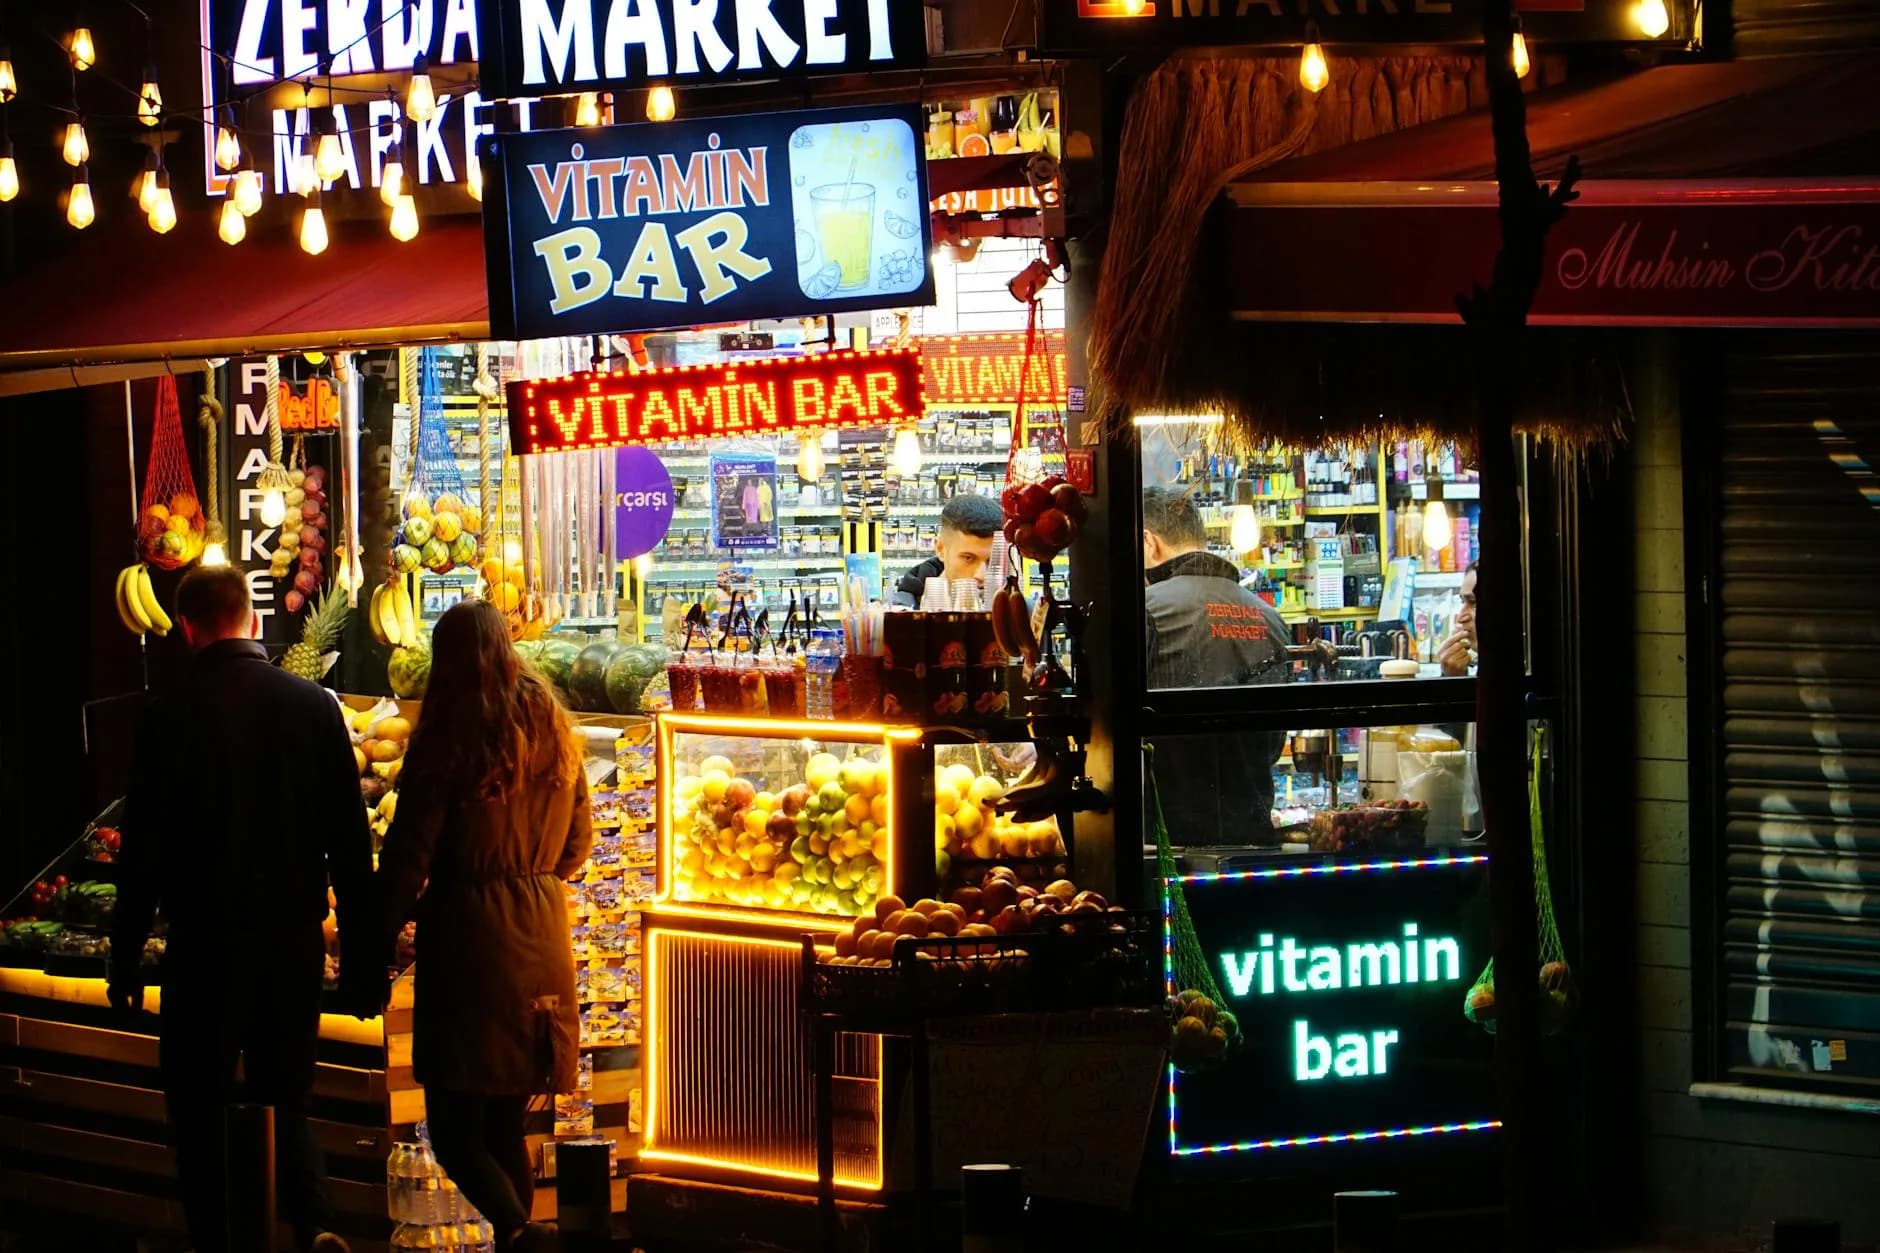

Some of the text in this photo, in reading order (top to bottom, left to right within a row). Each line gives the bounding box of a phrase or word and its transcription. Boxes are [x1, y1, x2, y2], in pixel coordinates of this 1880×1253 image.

[522, 0, 895, 85] MARKET
[929, 185, 1058, 212] ESH JUIC
[533, 211, 774, 316] BAR
[1557, 221, 1736, 290] Muhsin
[792, 371, 903, 423] BAR
[1211, 623, 1269, 640] MARKET
[1220, 922, 1460, 997] vitamin
[1294, 1019, 1399, 1081] bar
